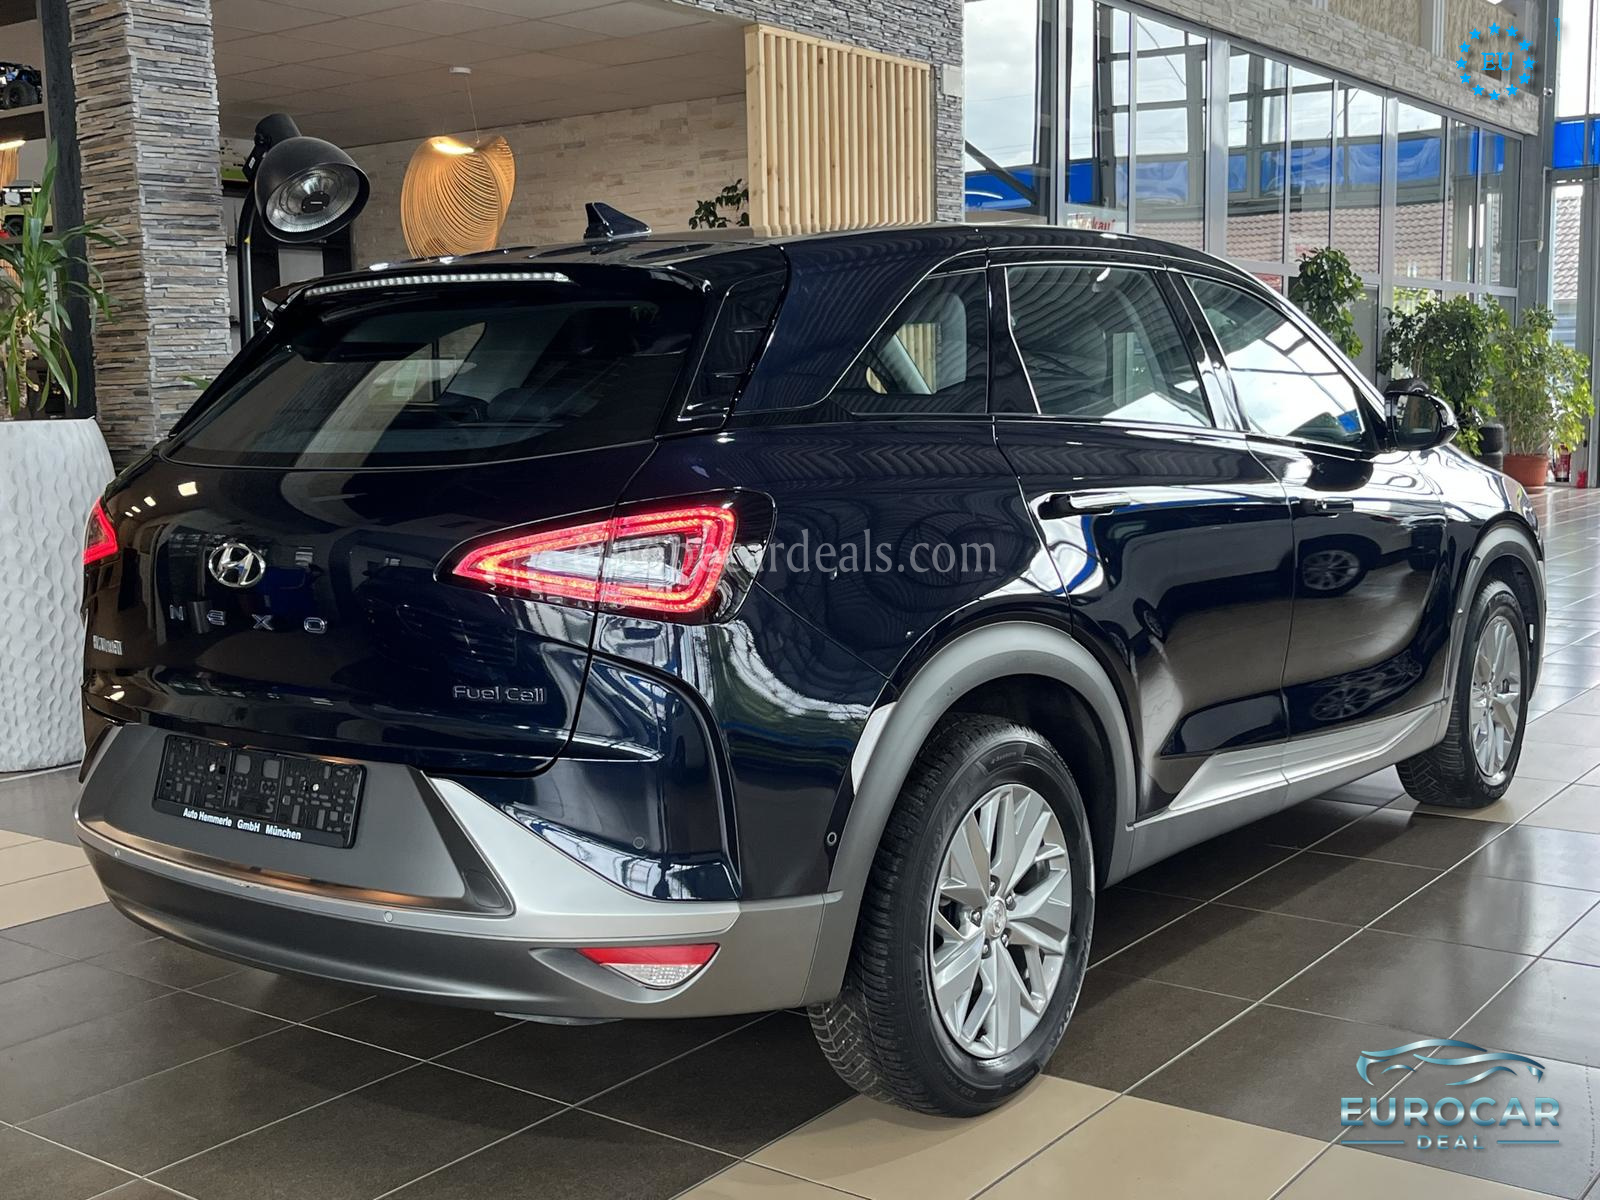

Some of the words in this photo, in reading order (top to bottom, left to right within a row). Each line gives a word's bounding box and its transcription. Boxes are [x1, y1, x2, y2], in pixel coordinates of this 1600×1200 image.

[169, 604, 328, 634] NEXO
[453, 685, 500, 701] Fuel
[504, 687, 545, 703] Cell
[182, 808, 198, 820] Auto
[198, 811, 233, 827] Hemmerle
[236, 819, 261, 833] GmbH
[265, 824, 302, 840] München
